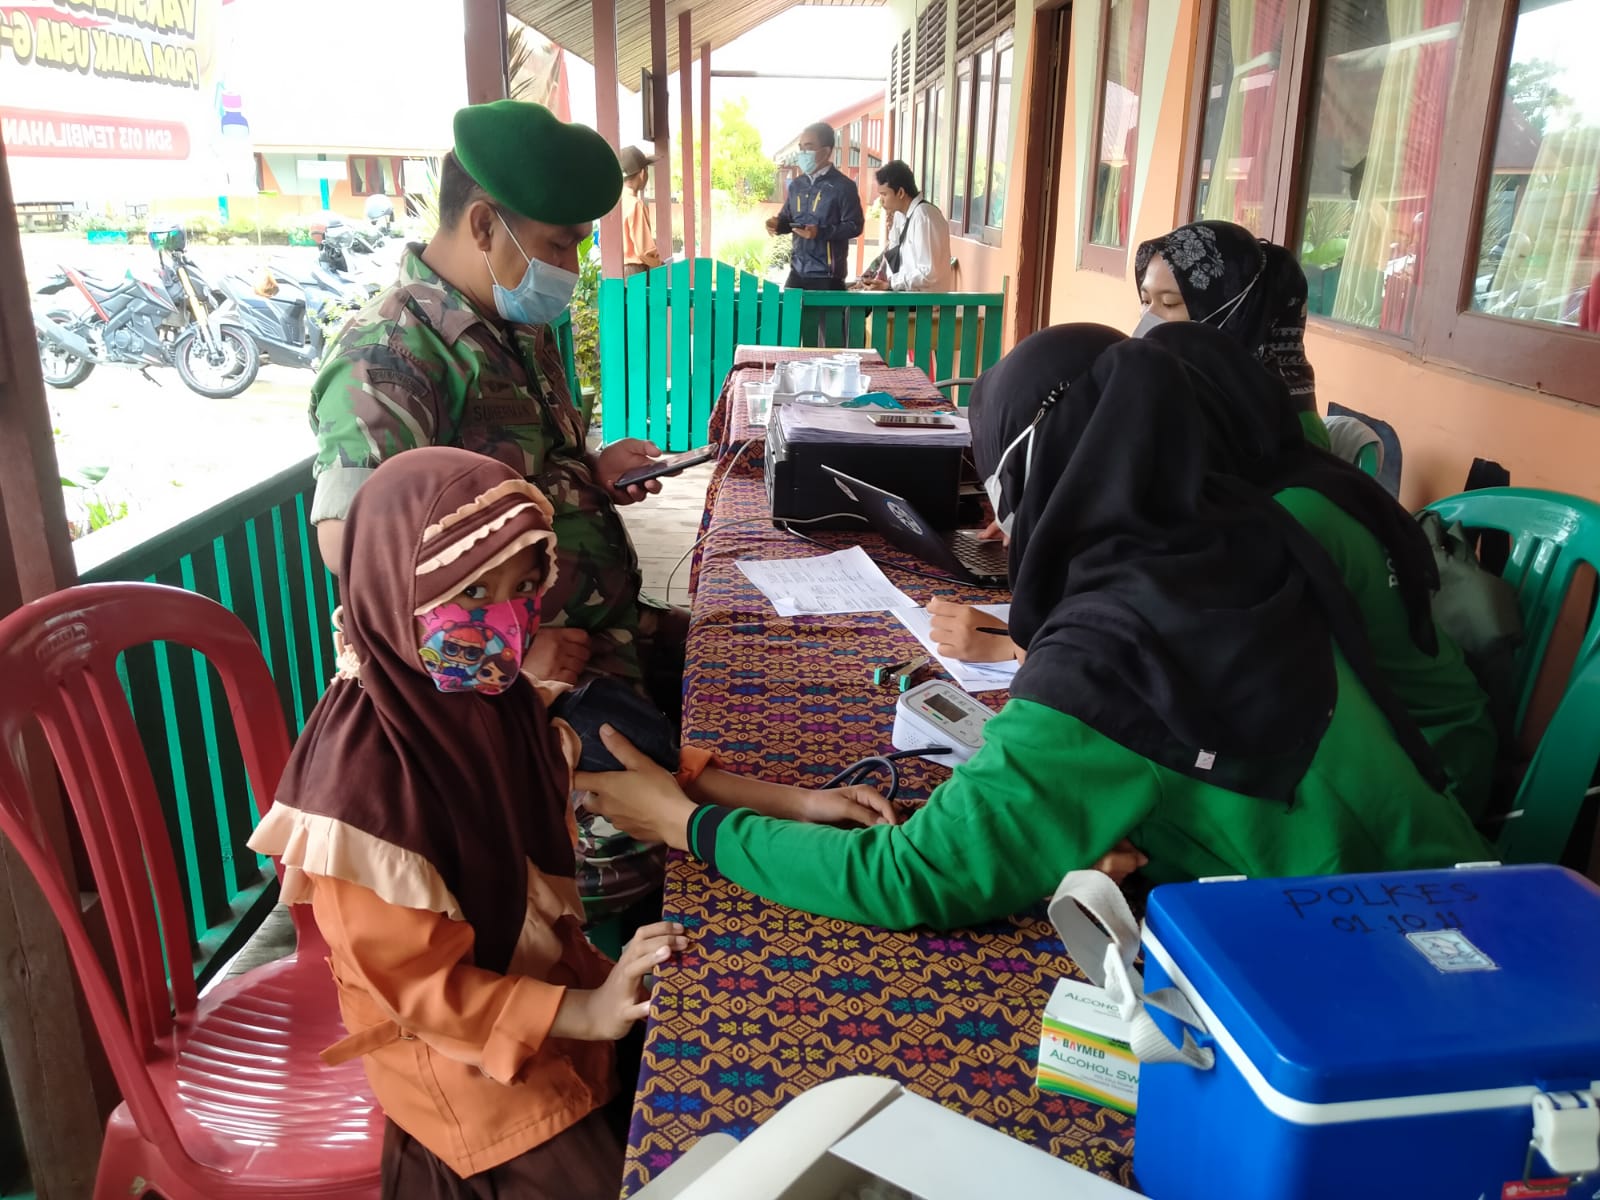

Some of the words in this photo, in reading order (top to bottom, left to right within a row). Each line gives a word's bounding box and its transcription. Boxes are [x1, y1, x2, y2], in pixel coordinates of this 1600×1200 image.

[1282, 883, 1479, 919] POLKES
[1065, 991, 1120, 1013] ALCOHO
[1062, 1037, 1106, 1060] BAYMED
[1049, 1048, 1114, 1078] ALCOHOL
[1115, 1069, 1139, 1085] SW
